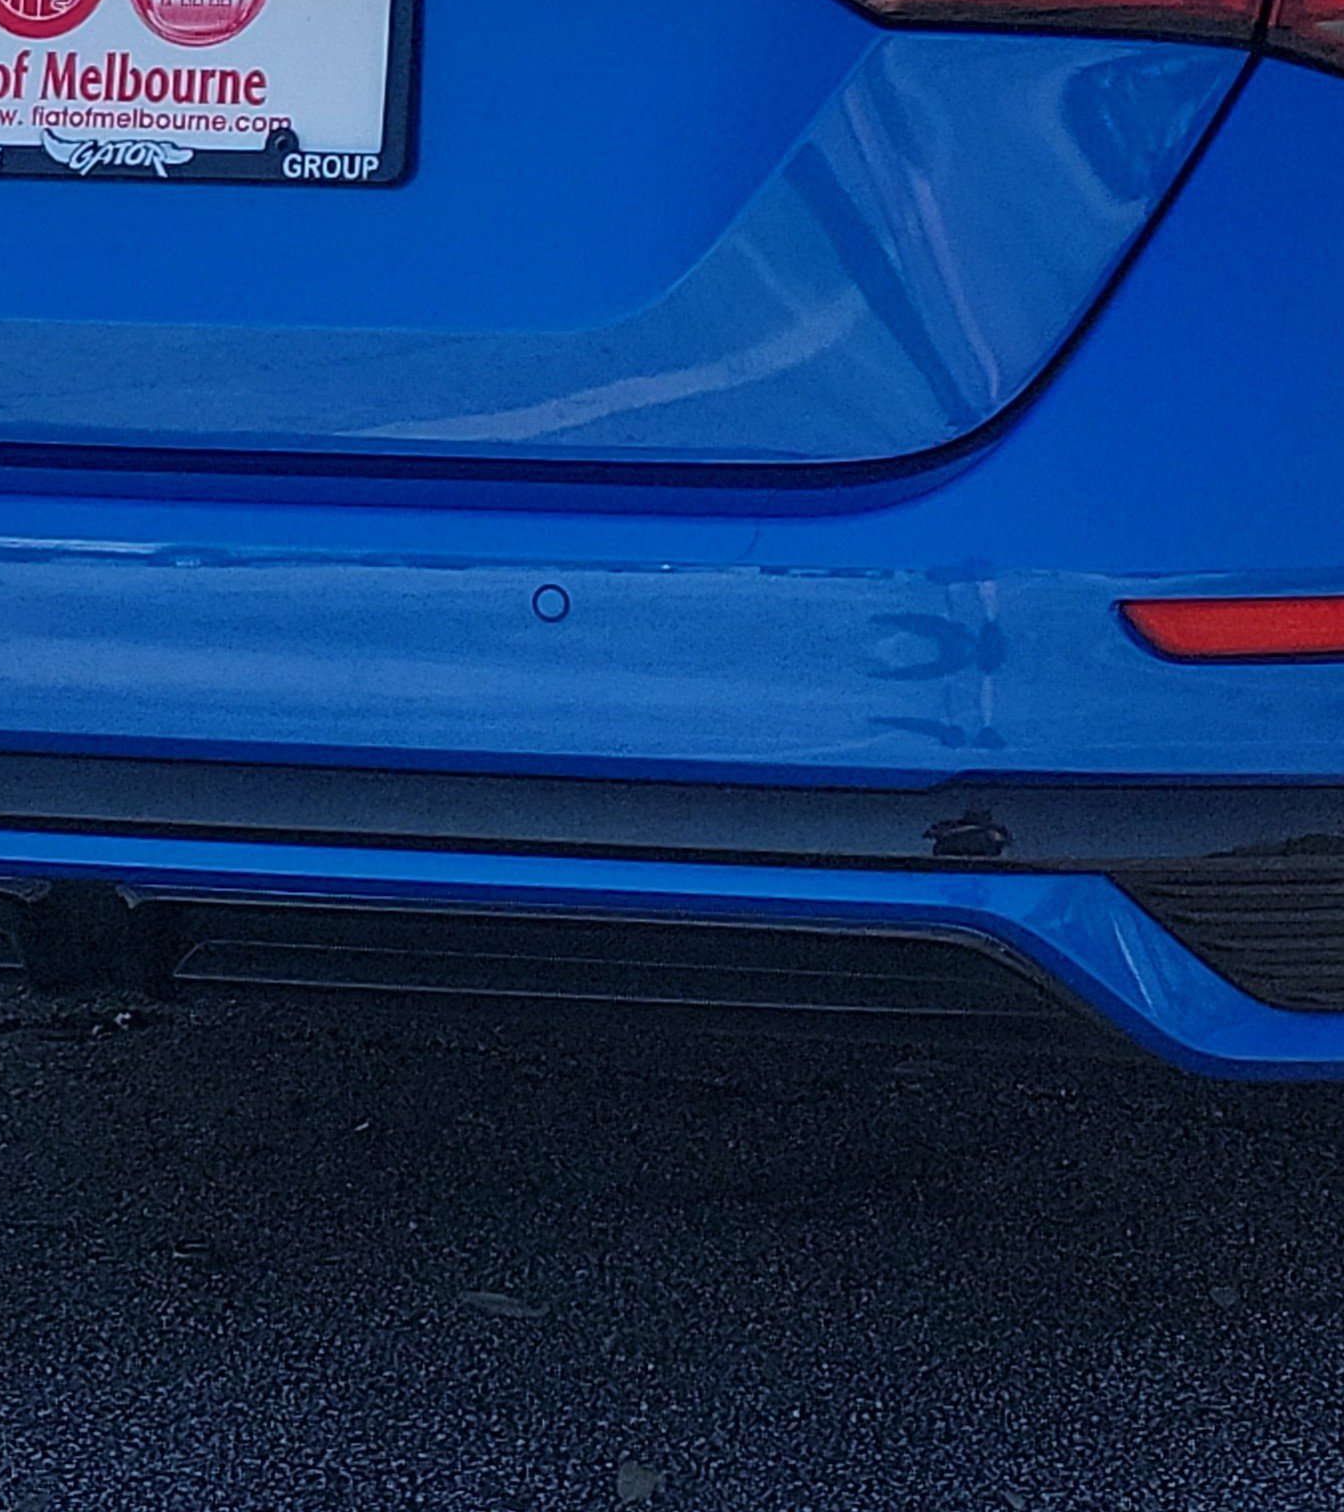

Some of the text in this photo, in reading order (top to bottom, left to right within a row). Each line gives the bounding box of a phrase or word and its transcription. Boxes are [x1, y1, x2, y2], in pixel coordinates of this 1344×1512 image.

[40, 50, 268, 107] Melbourne
[67, 139, 169, 178] GATOR
[282, 152, 380, 181] GROUP
